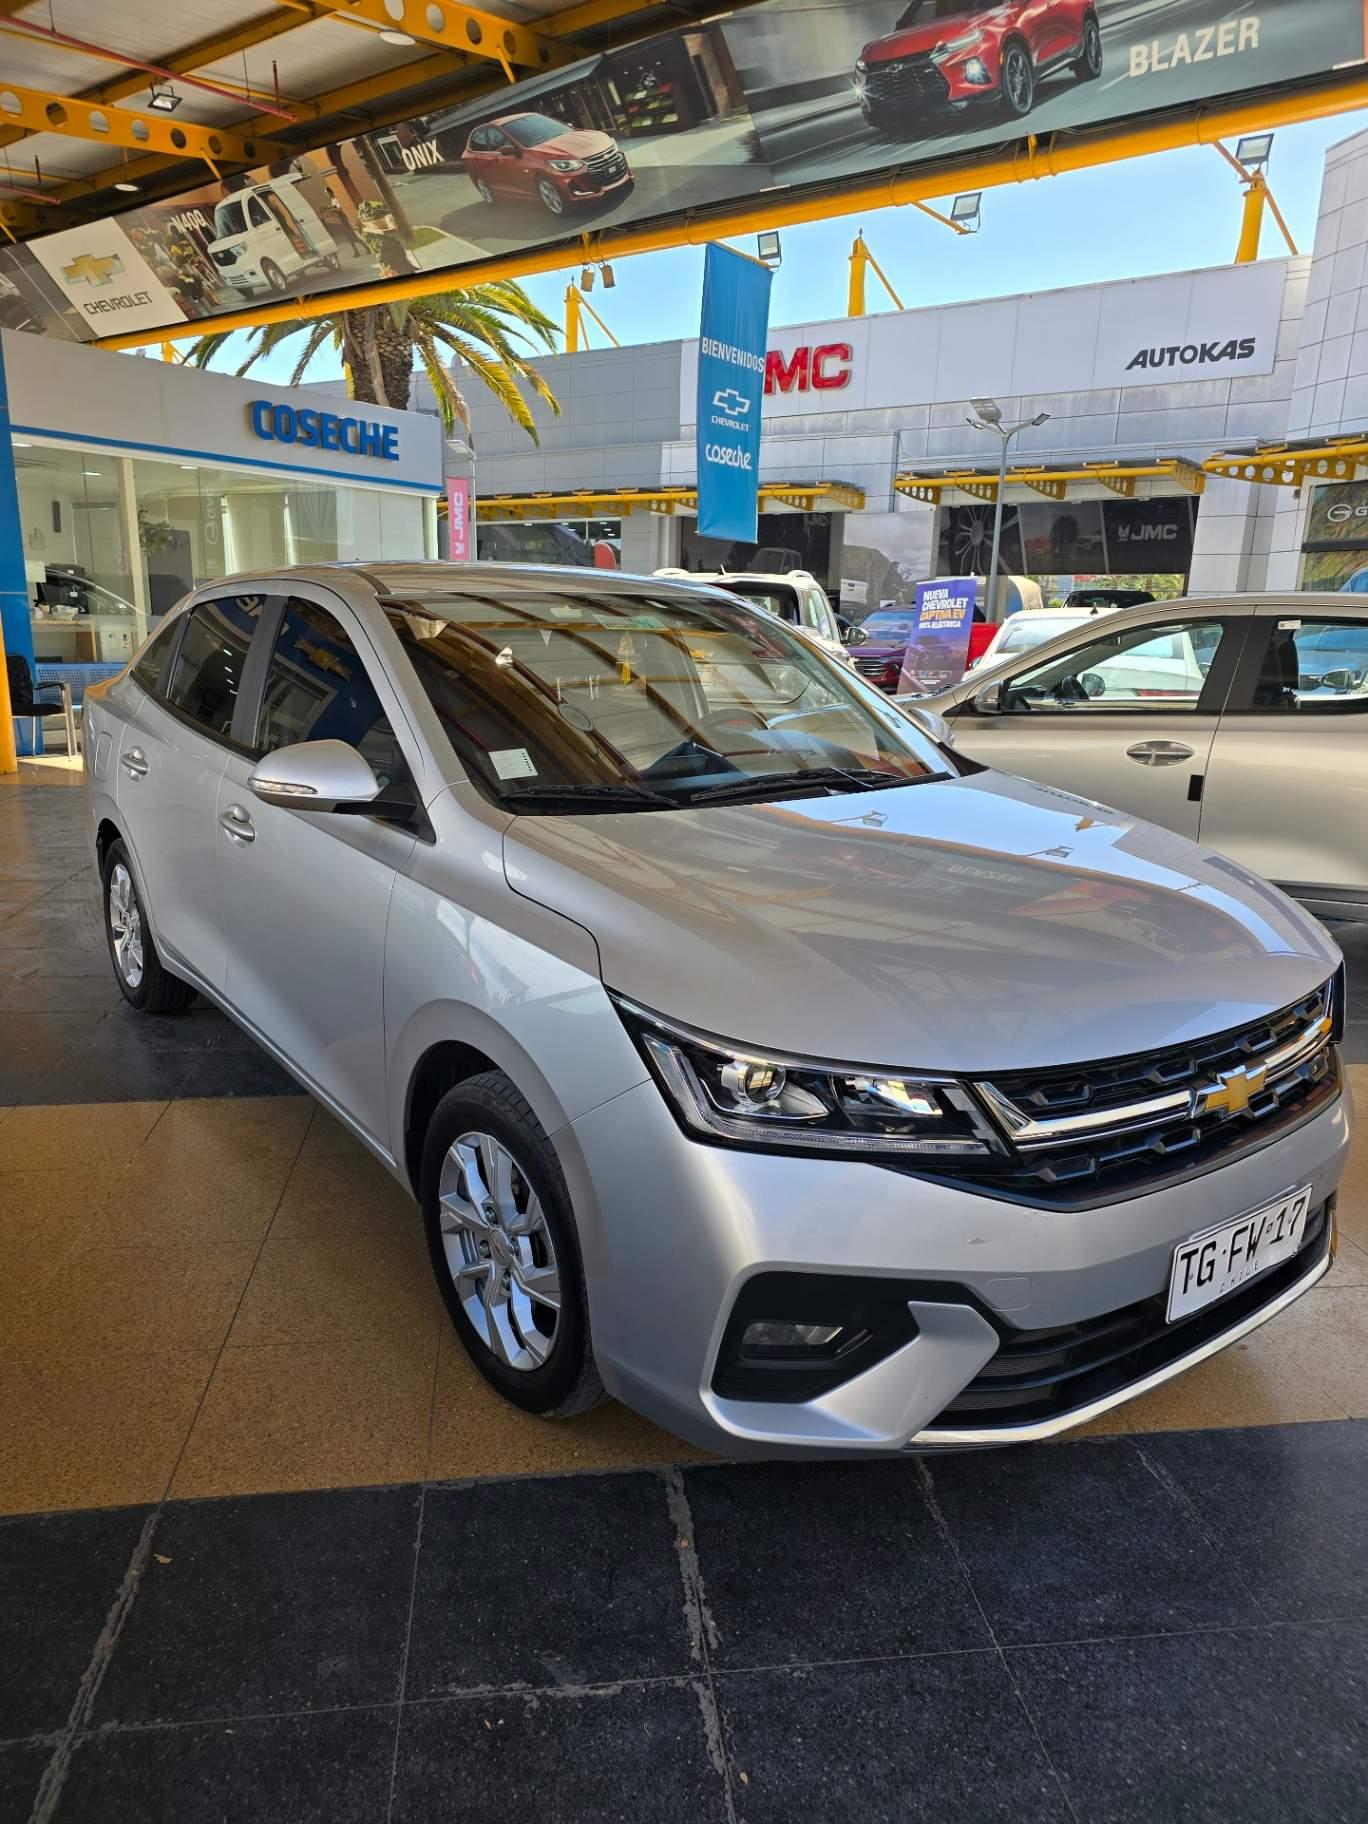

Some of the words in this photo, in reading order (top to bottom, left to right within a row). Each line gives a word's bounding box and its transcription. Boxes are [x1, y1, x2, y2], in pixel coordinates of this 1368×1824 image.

[1129, 16, 1260, 77] BLAZER
[401, 138, 445, 171] ONIX
[171, 209, 207, 233] N400
[83, 290, 153, 315] CHEVROLET
[702, 337, 765, 373] BIENVENIDOS
[1124, 337, 1256, 371] AUTOKAS
[764, 343, 852, 395] MC
[251, 400, 399, 461] COSECHE
[711, 415, 750, 432] CHEVROLET
[453, 491, 464, 540] JMC
[1130, 524, 1178, 540] JMC
[922, 597, 969, 612] CHEVROLET
[923, 588, 949, 602] NUEVA
[952, 609, 966, 619] EV
